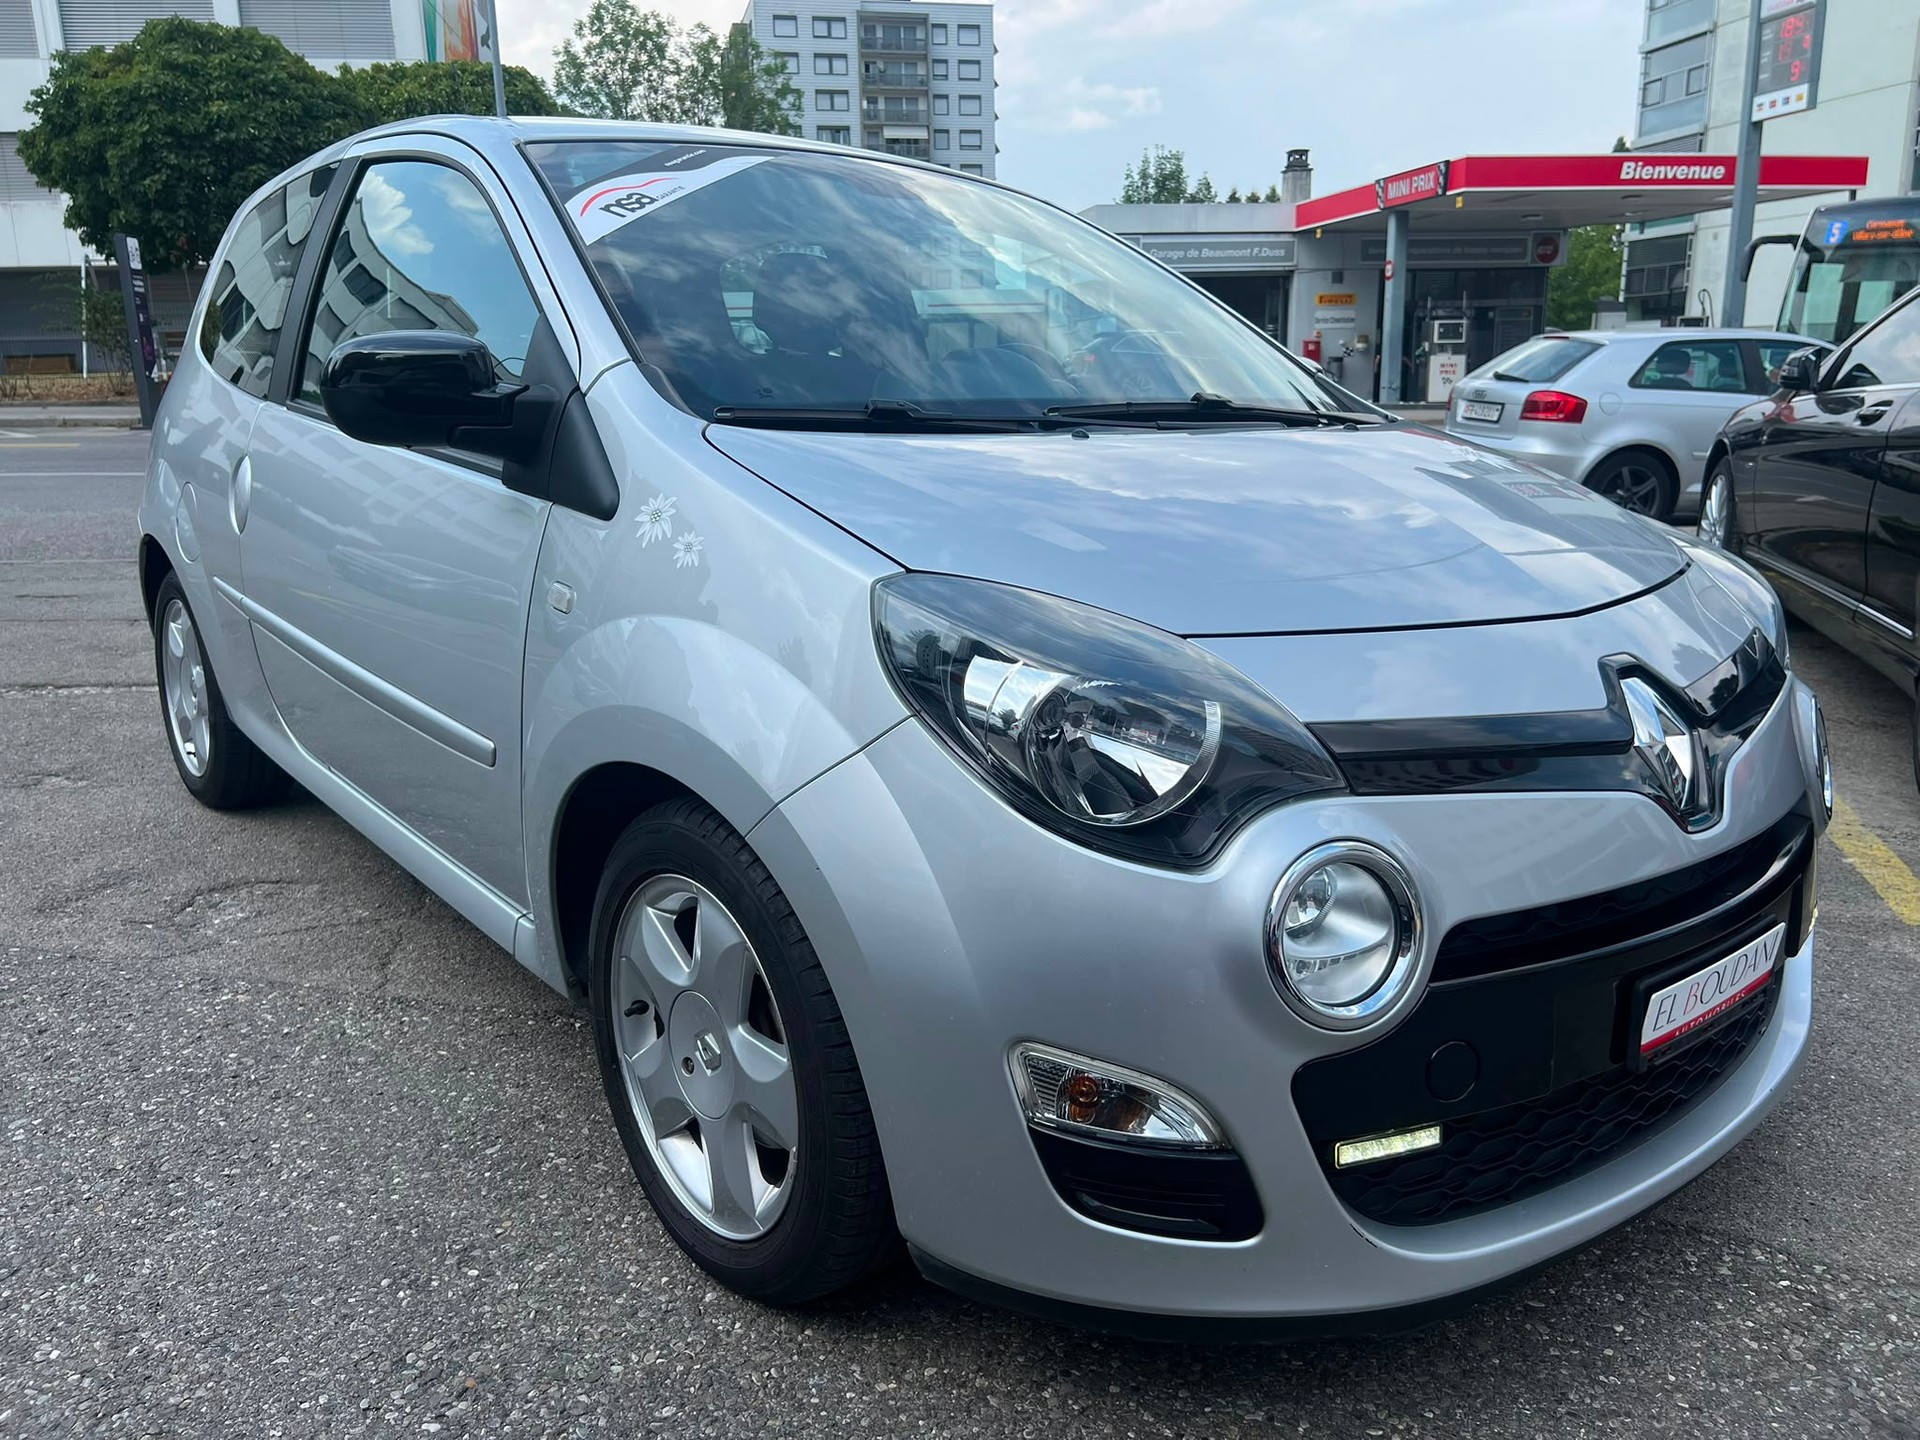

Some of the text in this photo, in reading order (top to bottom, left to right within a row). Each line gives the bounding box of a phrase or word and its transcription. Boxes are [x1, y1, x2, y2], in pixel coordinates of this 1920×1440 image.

[1620, 161, 1726, 180] Bienvenue
[1387, 171, 1436, 200] MINI PRIX
[599, 192, 660, 218] nsa
[1828, 222, 1844, 244] 5
[1150, 247, 1287, 260] Garage de Beaumont F.Duss
[1653, 931, 1779, 1032] EL BOUDANI
